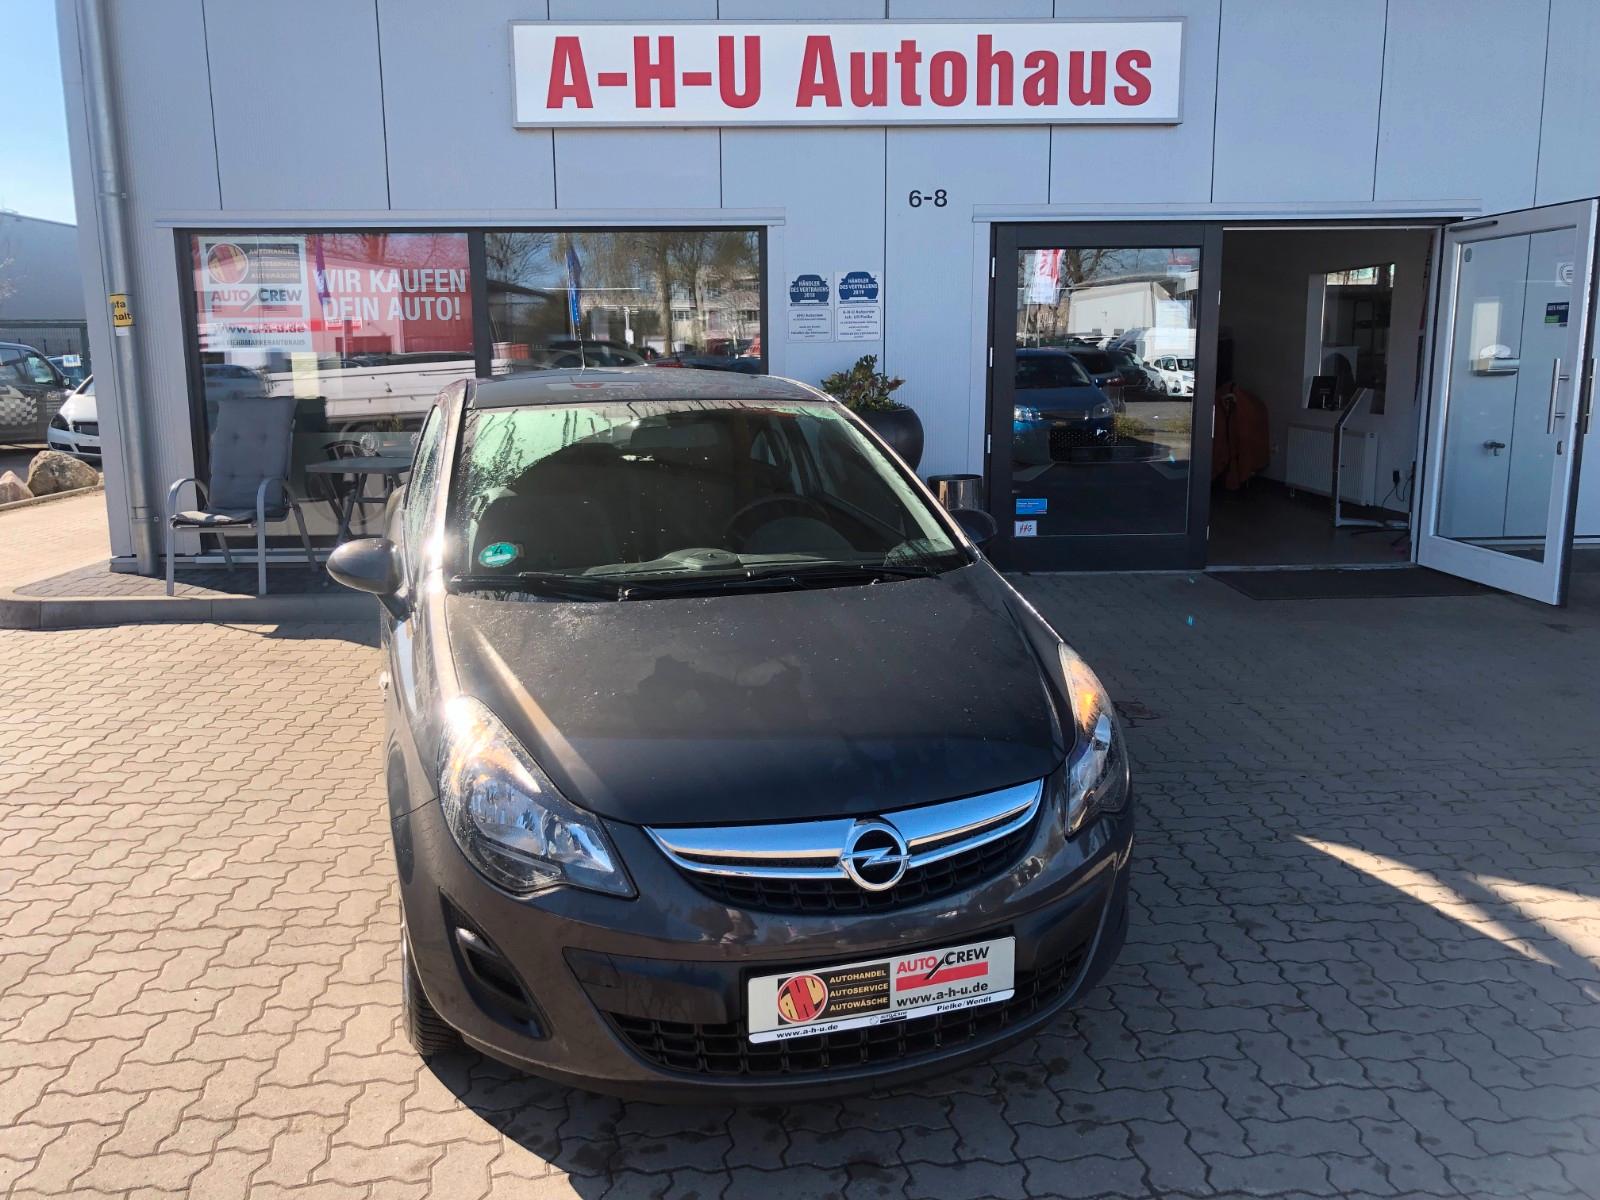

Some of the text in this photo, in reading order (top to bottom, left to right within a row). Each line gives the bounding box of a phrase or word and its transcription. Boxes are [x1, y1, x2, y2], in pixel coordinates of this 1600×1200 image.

[546, 33, 1152, 108] A-H-U Autohaus
[908, 189, 948, 208] 6-8
[313, 268, 466, 293] WIR KAUFEN
[211, 288, 302, 302] AUTO CREW
[322, 296, 461, 321] DEIN AUTO!
[494, 545, 503, 555] 4
[897, 946, 990, 974] AUTO CREW
[830, 969, 887, 984] AUTOHANDEL
[830, 982, 889, 998] AUTOSERVICE
[897, 982, 989, 1007] www.a-h-u.de
[830, 997, 889, 1012] AUTOWÄSCHE
[777, 1024, 838, 1039] www.a-h-u.de
